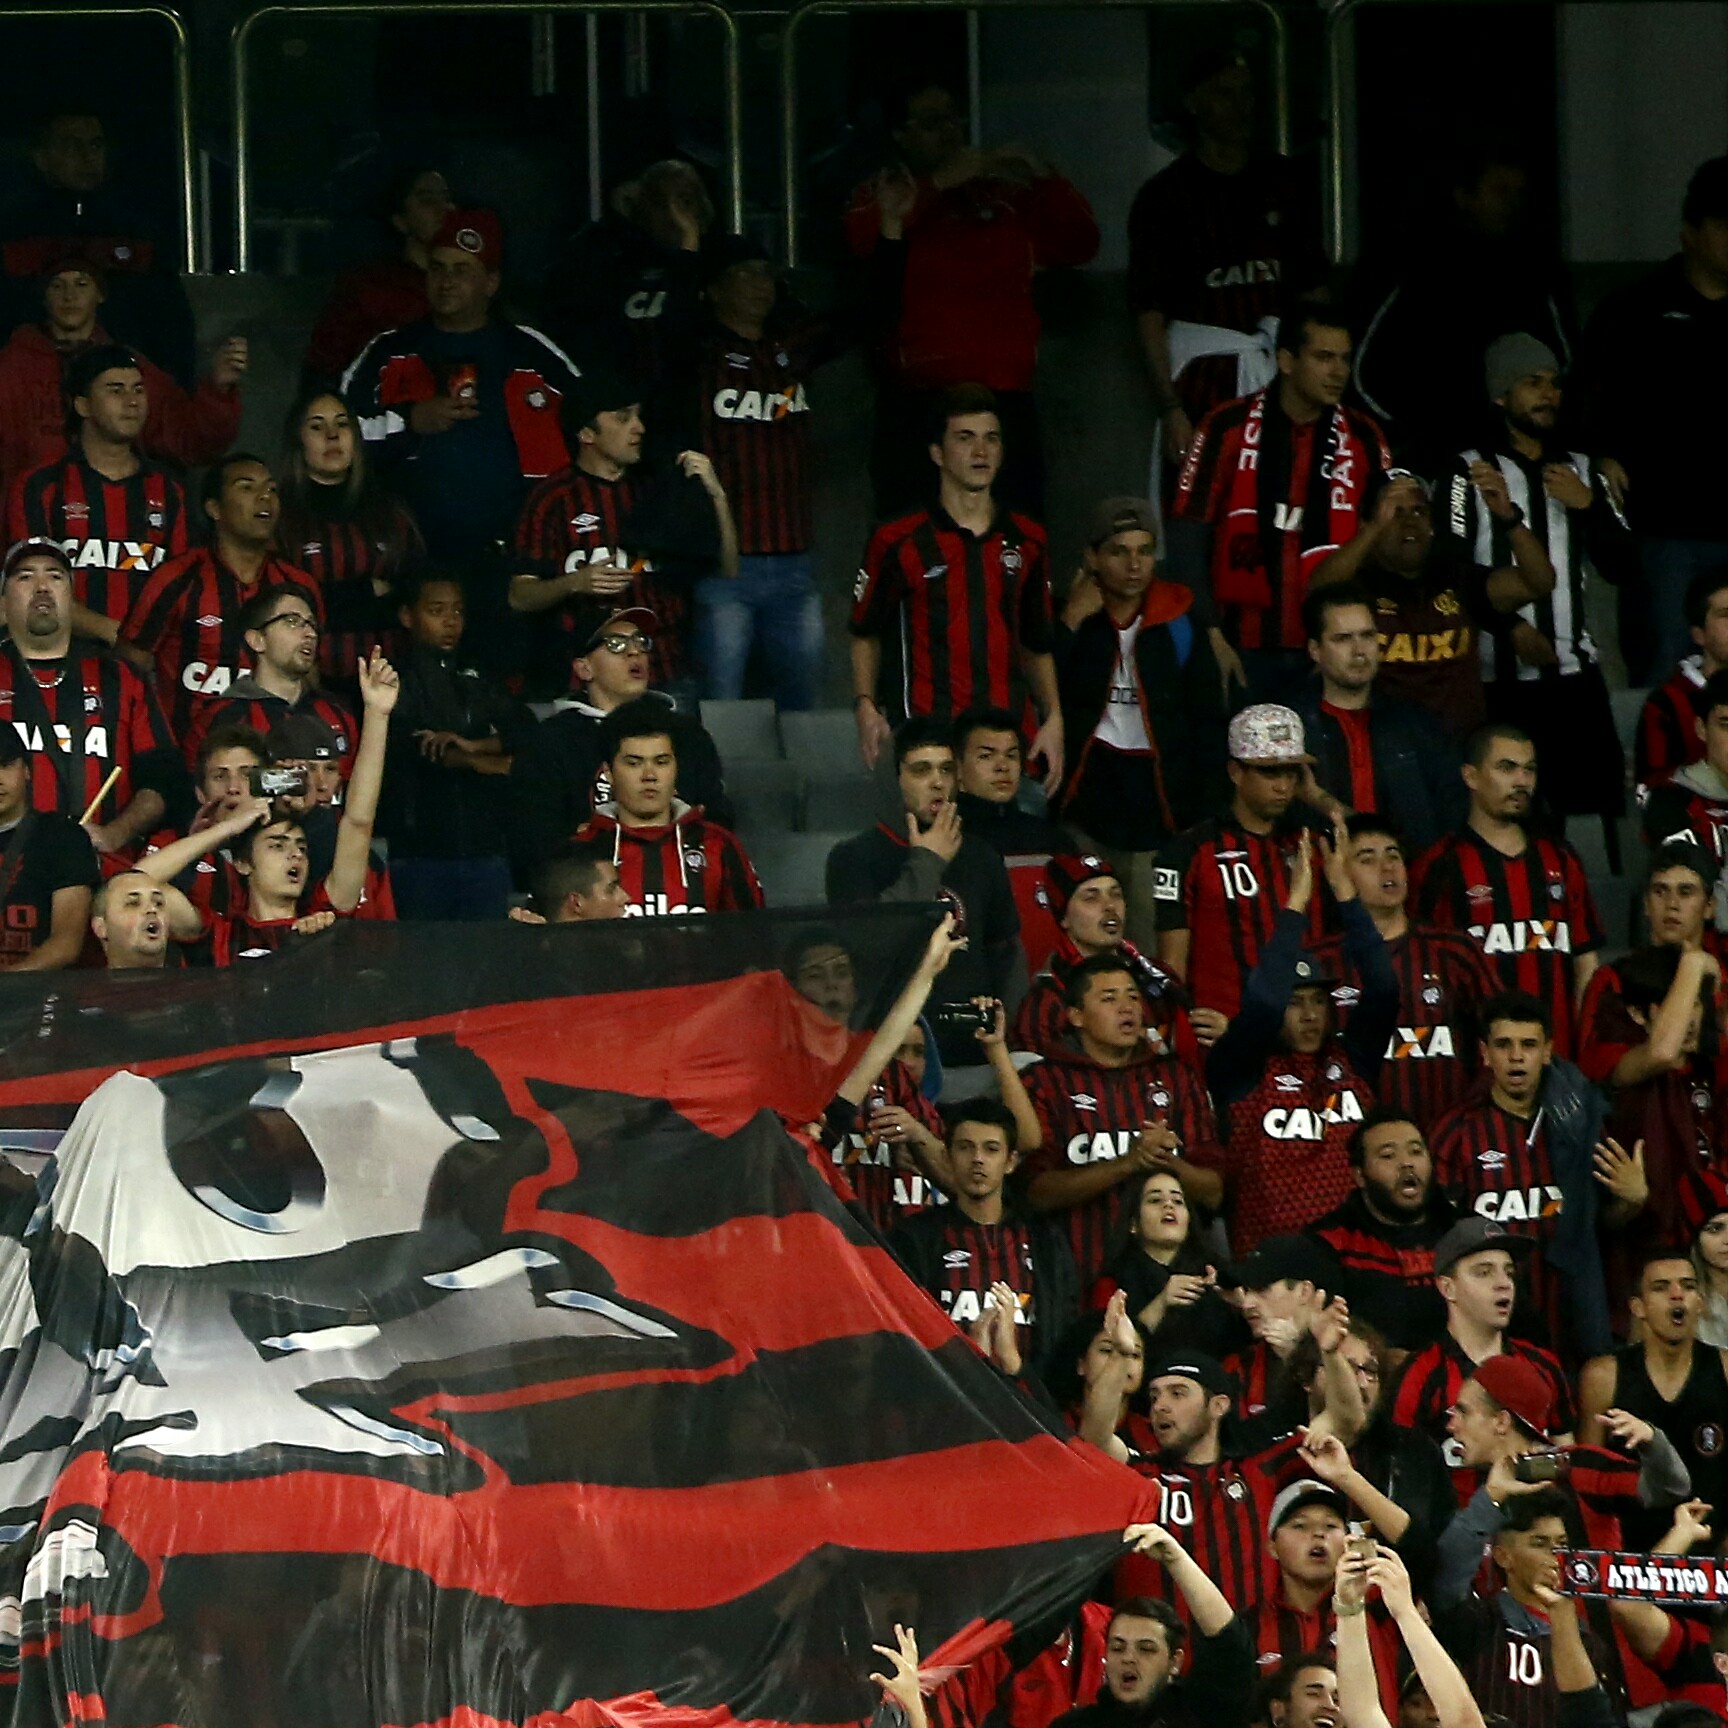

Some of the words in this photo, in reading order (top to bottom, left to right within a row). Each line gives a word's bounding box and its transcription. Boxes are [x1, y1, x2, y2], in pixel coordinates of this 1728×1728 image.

[1219, 862, 1260, 898] 10
[1160, 1489, 1192, 1528] 10
[1607, 1562, 1714, 1595] ATLÉTICO
[1507, 1642, 1543, 1687] 10
